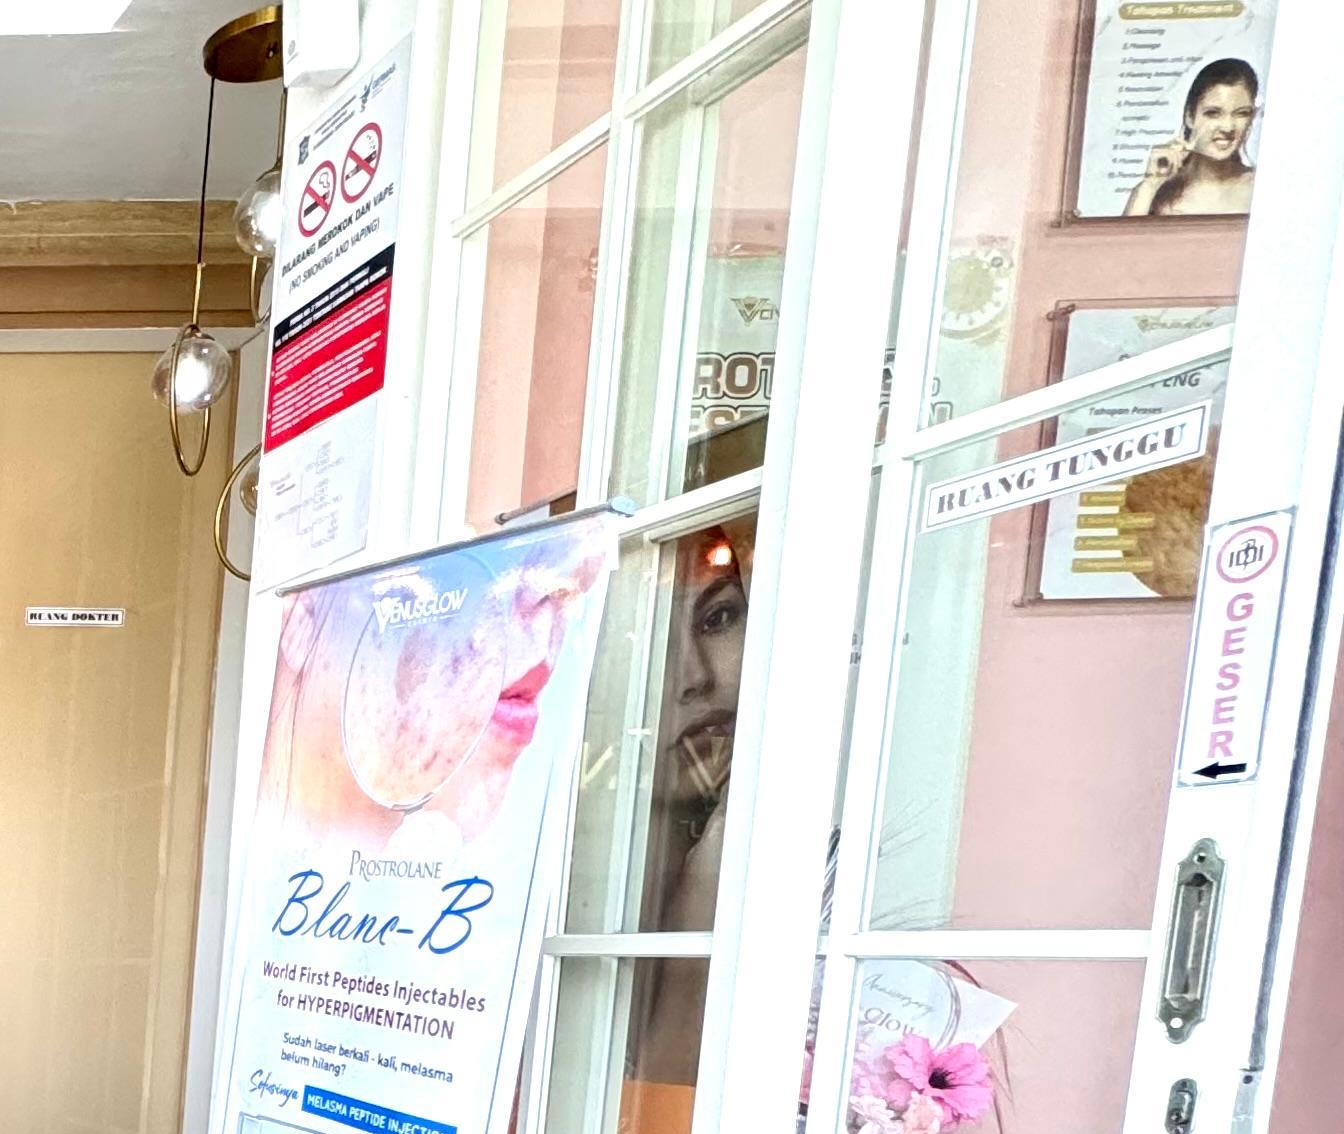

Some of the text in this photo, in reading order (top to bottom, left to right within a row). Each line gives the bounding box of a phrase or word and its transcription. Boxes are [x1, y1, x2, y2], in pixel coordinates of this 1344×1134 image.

[282, 182, 394, 278] DILARANG MEROKOK DAN VAPE
[302, 252, 333, 285] SMOKING
[335, 240, 349, 258] AND
[936, 423, 1187, 514] RUANG TUNGGU
[30, 612, 119, 622] RUANG DOKTER
[263, 960, 486, 1013] World First Peptides Injectables
[277, 989, 455, 1040] for HYPERPIGMENTATION
[281, 1048, 346, 1077] belum hilang?
[283, 1032, 312, 1049] Sudah
[314, 1038, 337, 1055] laser
[339, 1043, 370, 1063] berkali
[400, 1060, 453, 1083] melasma
[307, 1093, 348, 1117] MELASMA
[349, 1106, 385, 1129] PEPTIDE
